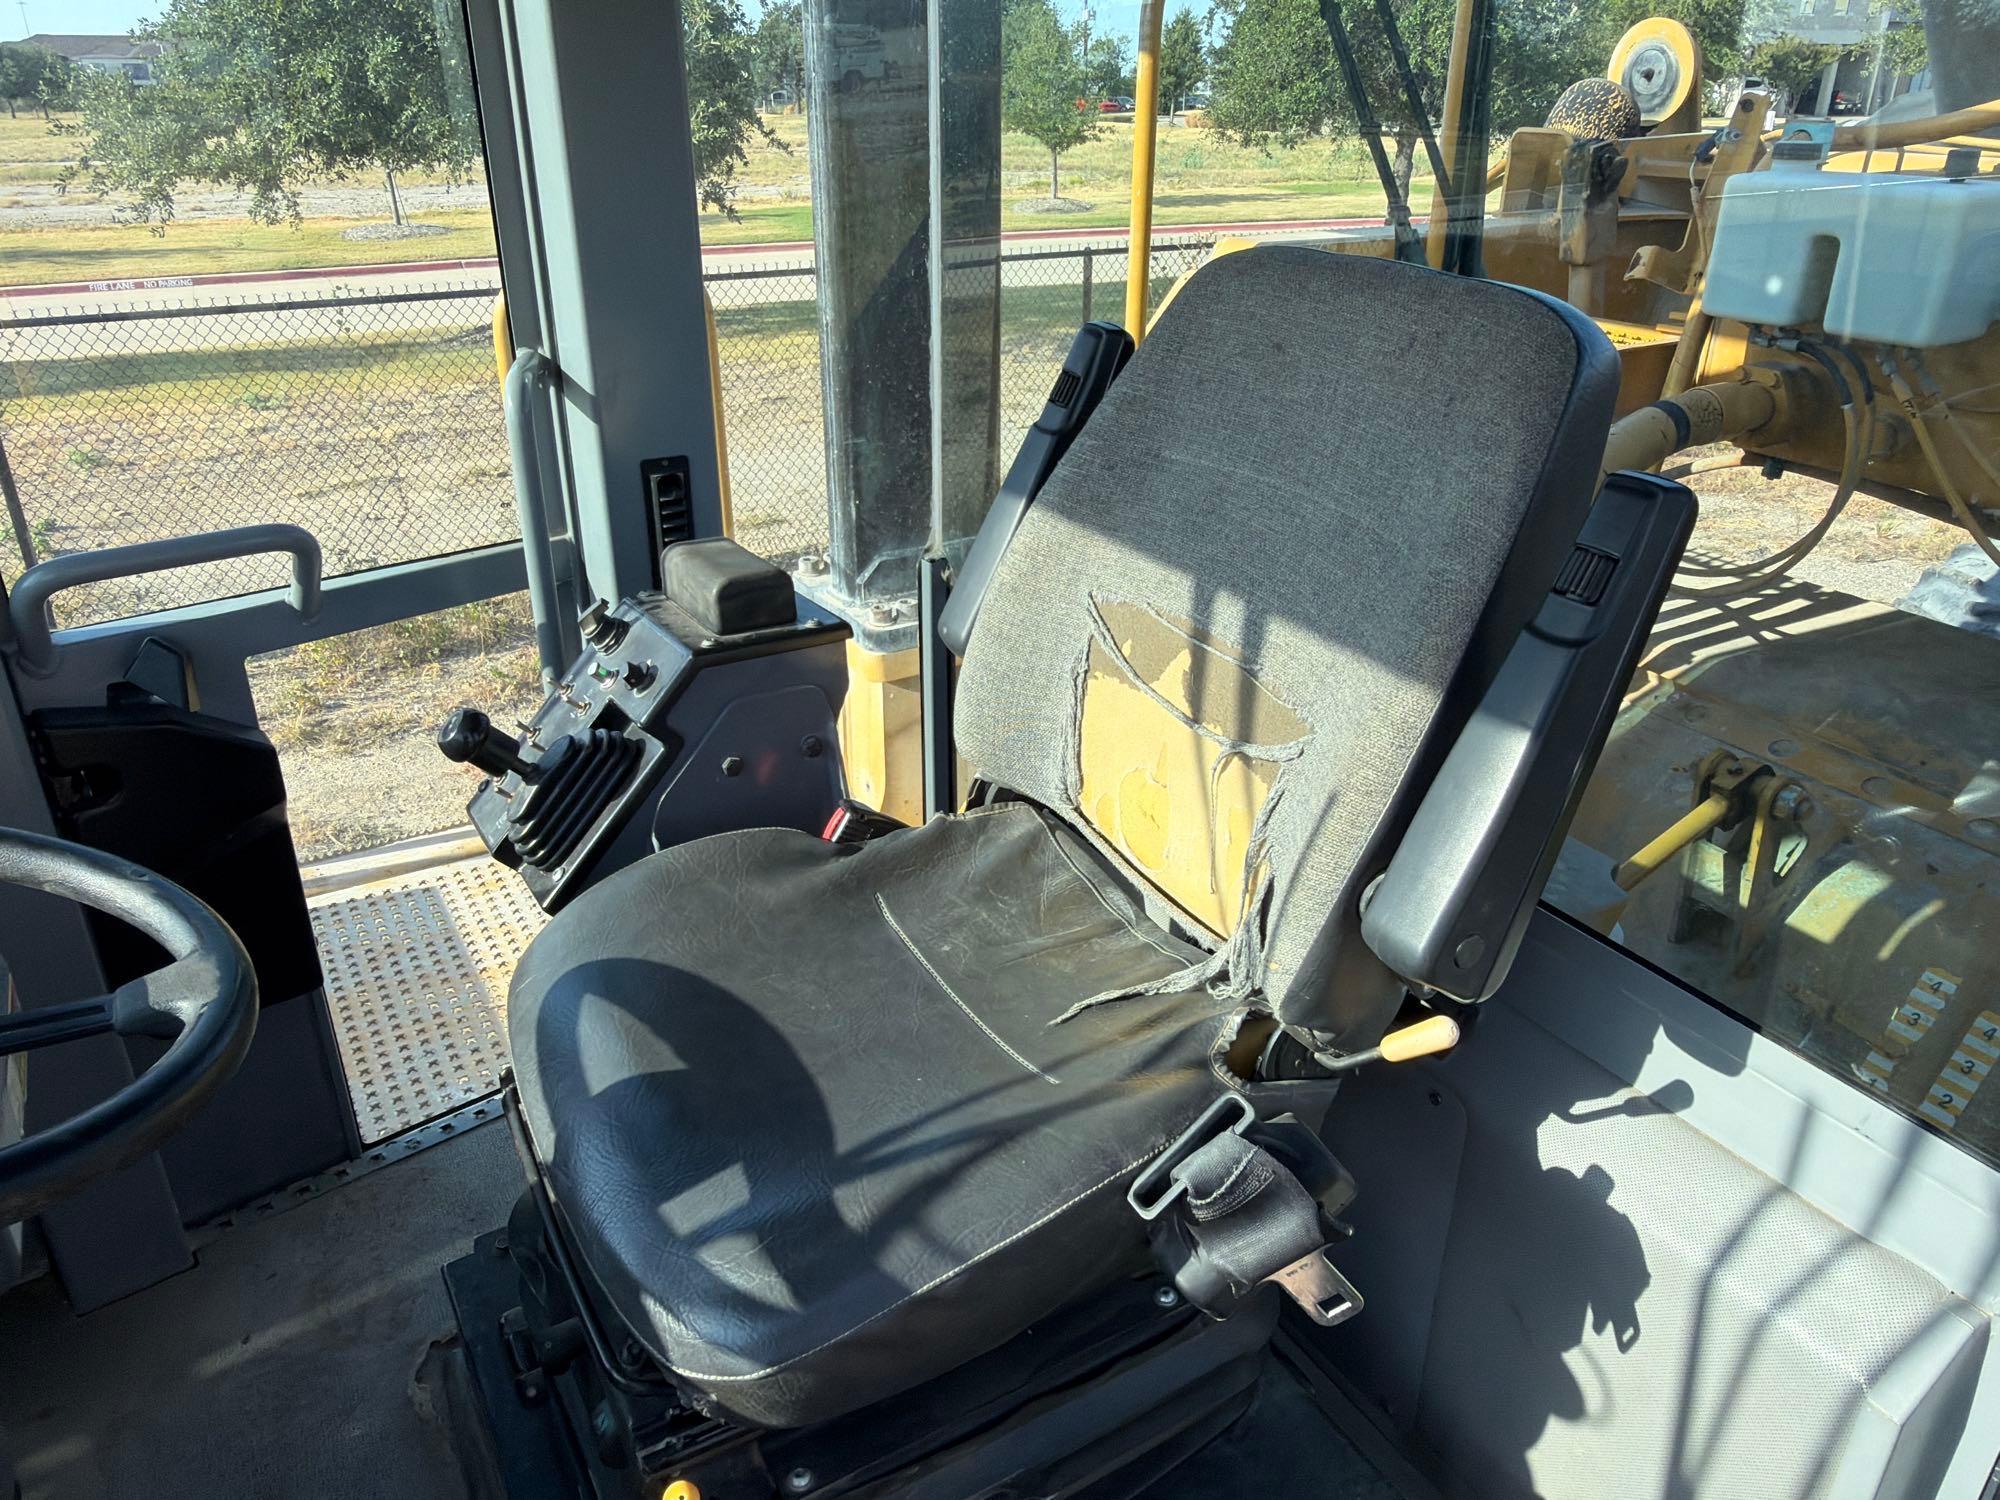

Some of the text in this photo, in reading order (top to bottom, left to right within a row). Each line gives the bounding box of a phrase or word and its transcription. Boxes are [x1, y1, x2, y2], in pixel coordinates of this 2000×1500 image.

[89, 278, 193, 292] FIRE LANE NO PARKING
[1931, 981, 1943, 994] 4
[1907, 1012, 1921, 1025] 3
[1984, 1027, 1998, 1040] 4
[1961, 1060, 1975, 1074] 3
[1938, 1093, 1953, 1109] 2
